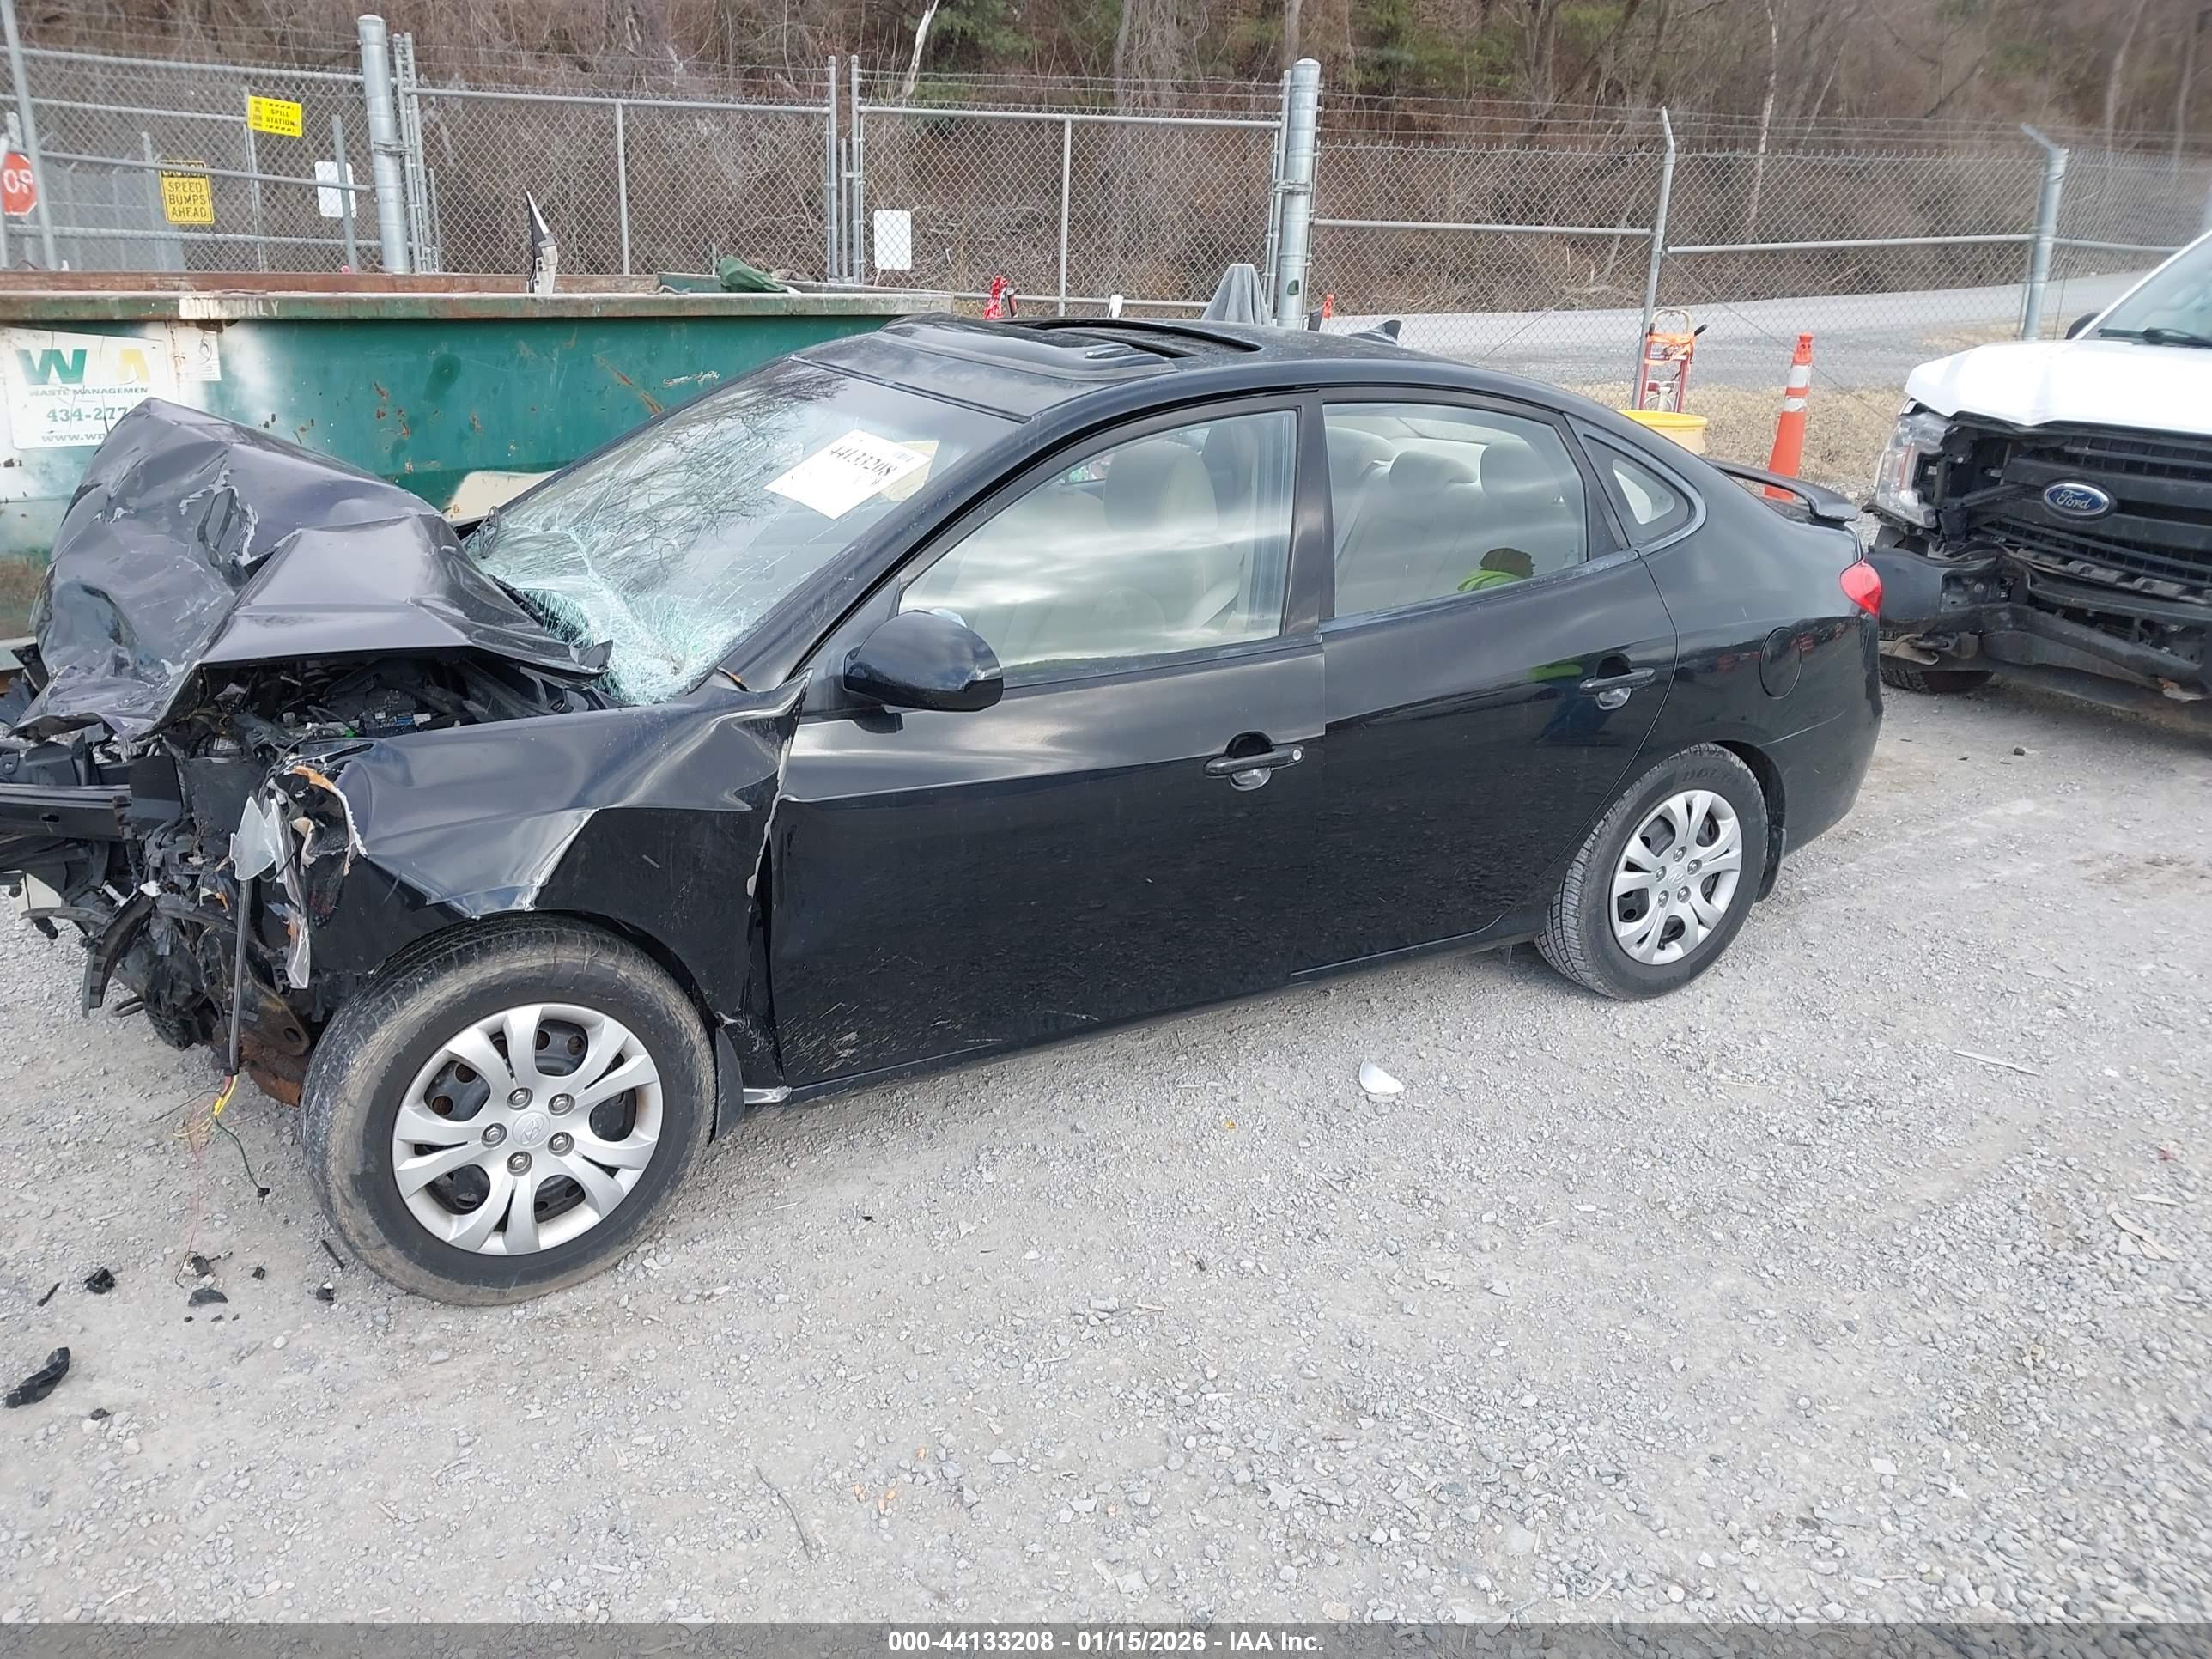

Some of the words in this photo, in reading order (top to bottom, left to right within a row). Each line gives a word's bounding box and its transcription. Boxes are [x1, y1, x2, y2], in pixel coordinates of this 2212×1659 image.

[270, 108, 289, 117] SPILL
[266, 117, 295, 127] STATION
[168, 181, 203, 193] SPEED
[168, 194, 206, 205] BUMPS
[172, 206, 207, 217] AHEAD
[2057, 489, 2091, 510] Ford
